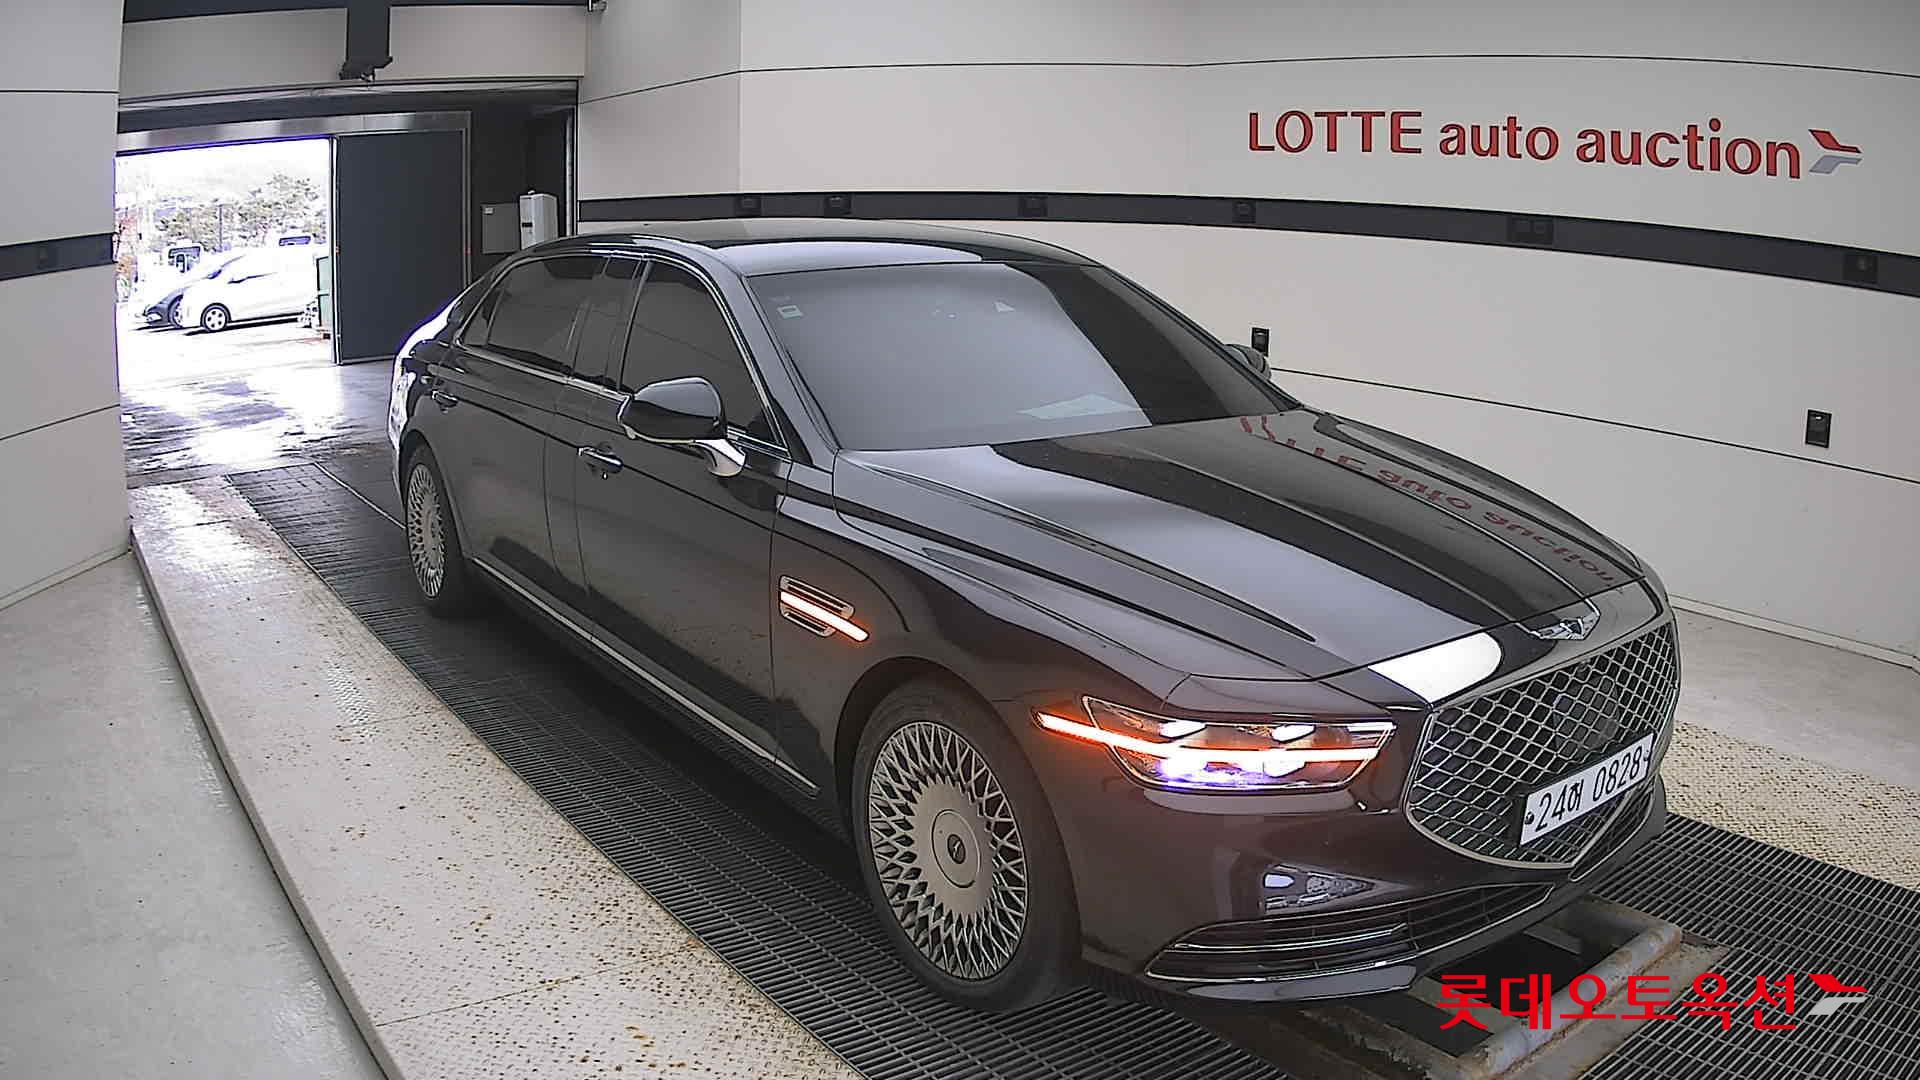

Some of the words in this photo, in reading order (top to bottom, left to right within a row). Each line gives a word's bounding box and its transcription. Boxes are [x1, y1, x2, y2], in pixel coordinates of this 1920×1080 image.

[1248, 110, 1423, 155] LOTTE
[1438, 115, 1560, 161] auto
[1576, 117, 1801, 179] auction
[1535, 778, 1585, 833] 24허
[1592, 745, 1643, 802] 0828
